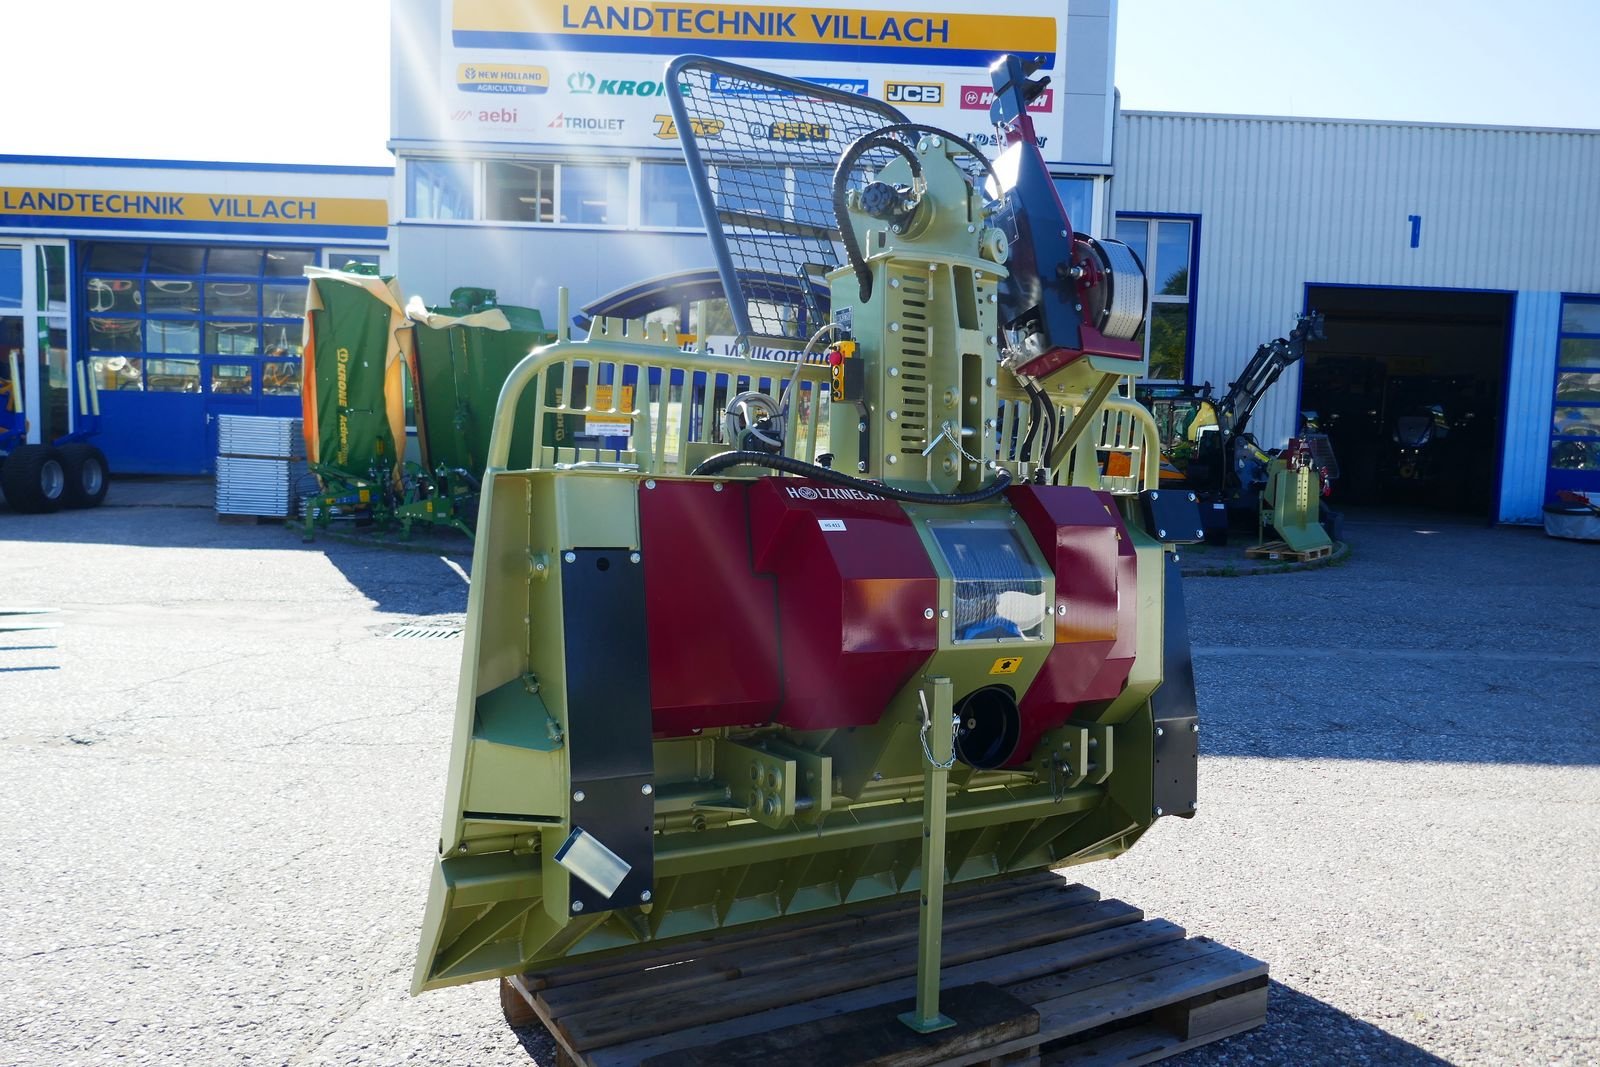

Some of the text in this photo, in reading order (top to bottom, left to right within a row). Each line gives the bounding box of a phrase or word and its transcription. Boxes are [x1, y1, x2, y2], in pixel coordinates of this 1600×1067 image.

[562, 4, 949, 43] LANDTECHNIK VILLACH
[478, 71, 542, 81] NEW HOLLAND
[477, 84, 527, 93] AGRICULTURE
[887, 85, 940, 103] JCB
[478, 108, 518, 123] aebi
[564, 117, 625, 130] TRIOLIET
[4, 191, 317, 220] LANDTECHNIK VILLACH
[1408, 215, 1421, 248] 1
[337, 363, 348, 407] KRONE
[785, 486, 886, 501] HOLZKNECH
